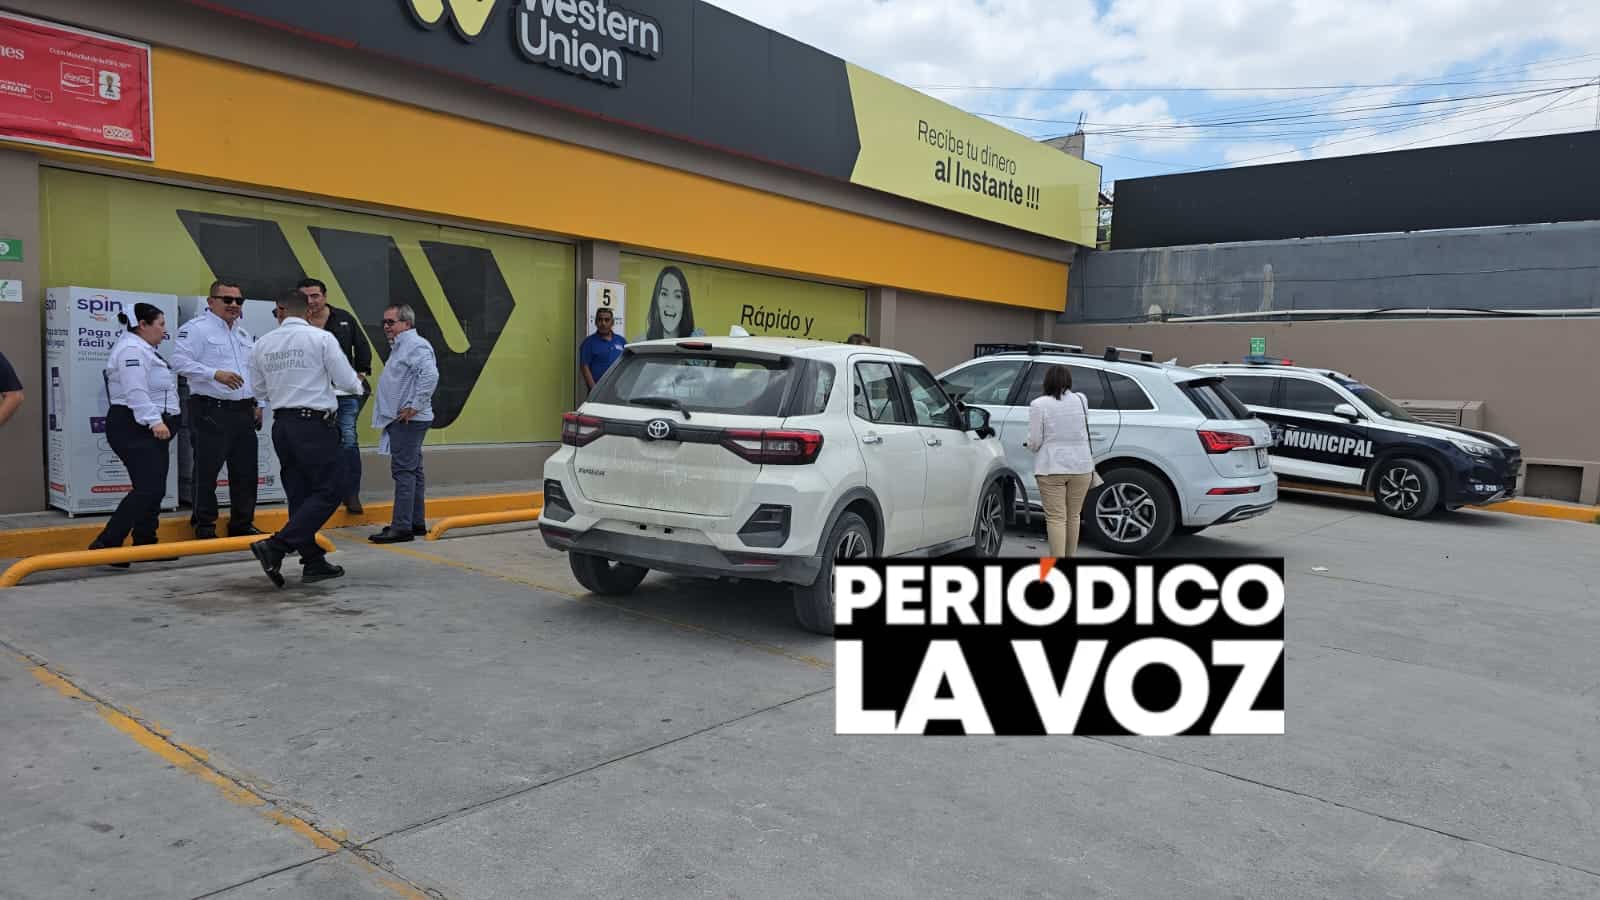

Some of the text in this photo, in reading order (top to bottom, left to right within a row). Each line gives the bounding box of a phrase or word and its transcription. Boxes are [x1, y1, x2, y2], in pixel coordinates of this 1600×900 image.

[520, 12, 623, 81] Union
[918, 120, 1017, 175] Recibe tu dinero
[934, 157, 951, 183] al
[956, 161, 1023, 205] Instante
[77, 296, 122, 313] spin
[602, 288, 611, 306] 5
[78, 328, 111, 338] Paga
[740, 304, 815, 337] Rápido y
[78, 337, 115, 349] fácil y
[1284, 430, 1374, 458] MUNICIPAL
